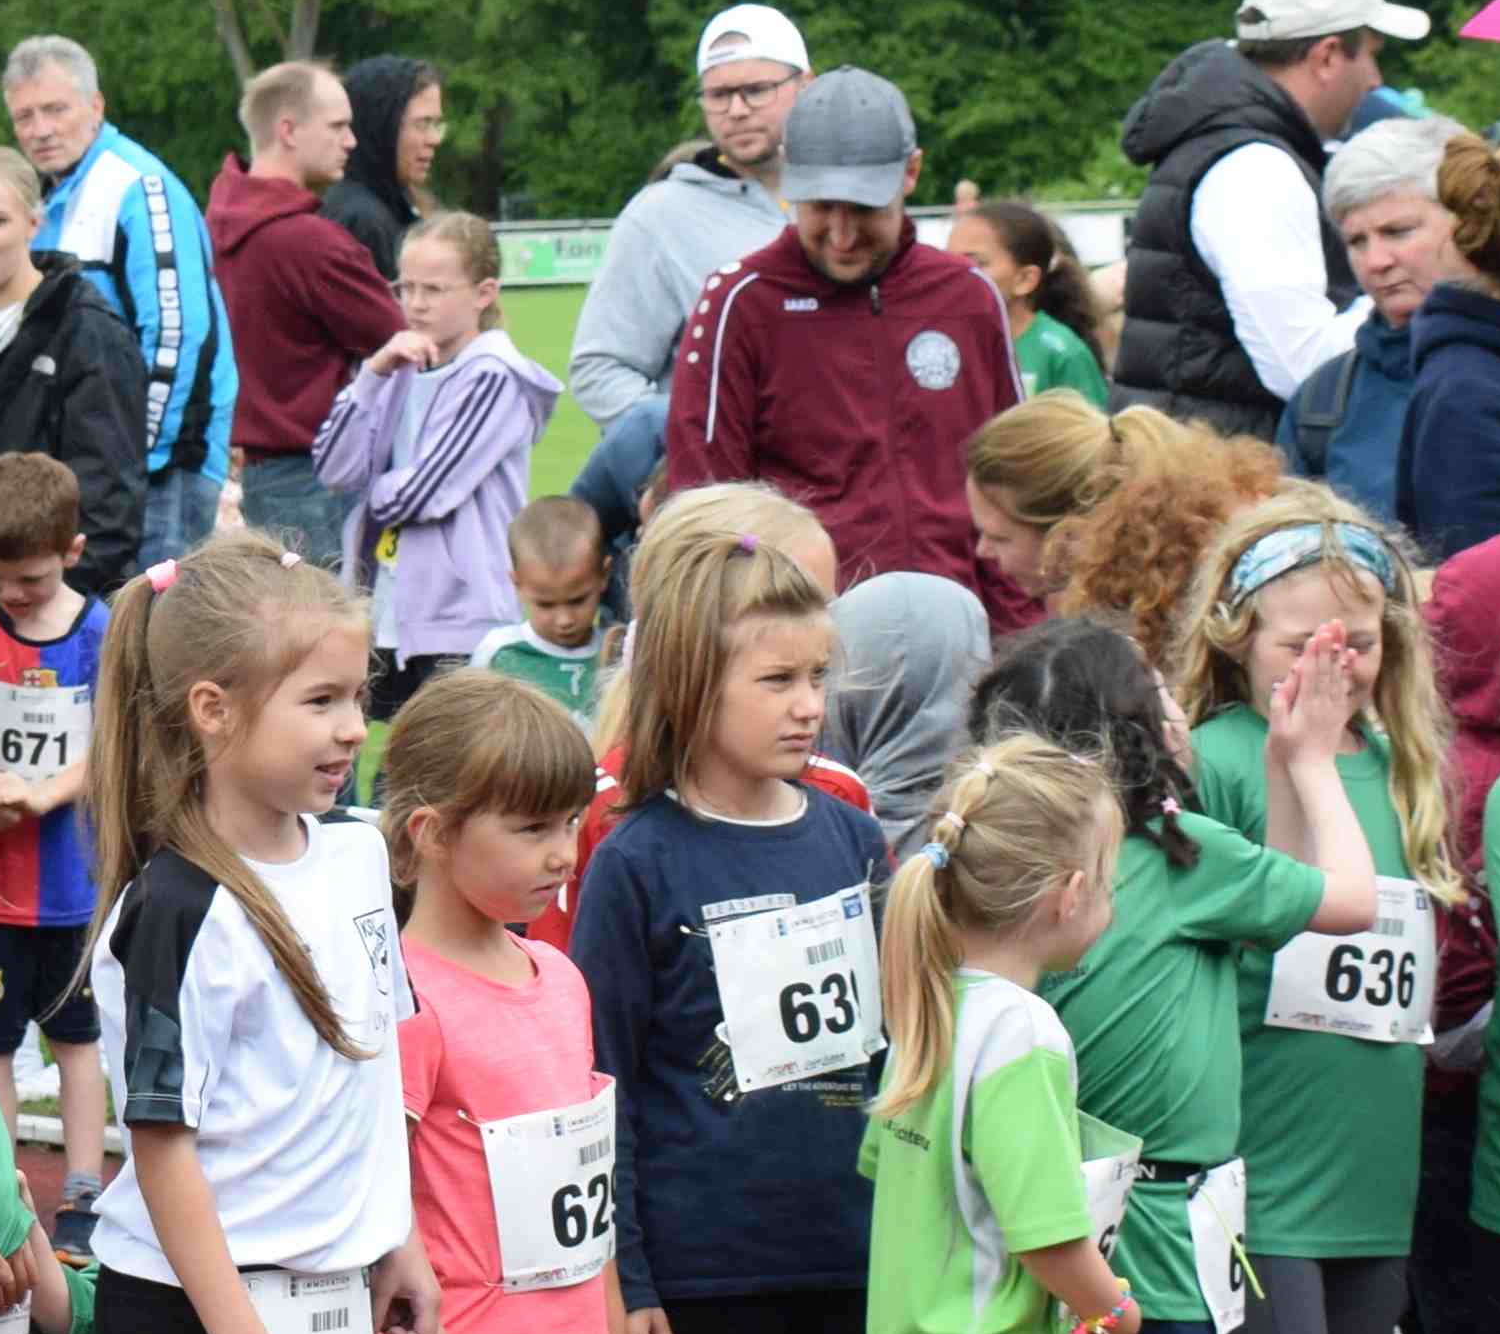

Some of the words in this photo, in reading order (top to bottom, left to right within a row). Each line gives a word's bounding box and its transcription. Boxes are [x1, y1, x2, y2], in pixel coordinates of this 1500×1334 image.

[1, 728, 68, 766] 671
[779, 968, 861, 1044] 63
[1325, 944, 1416, 1009] 636
